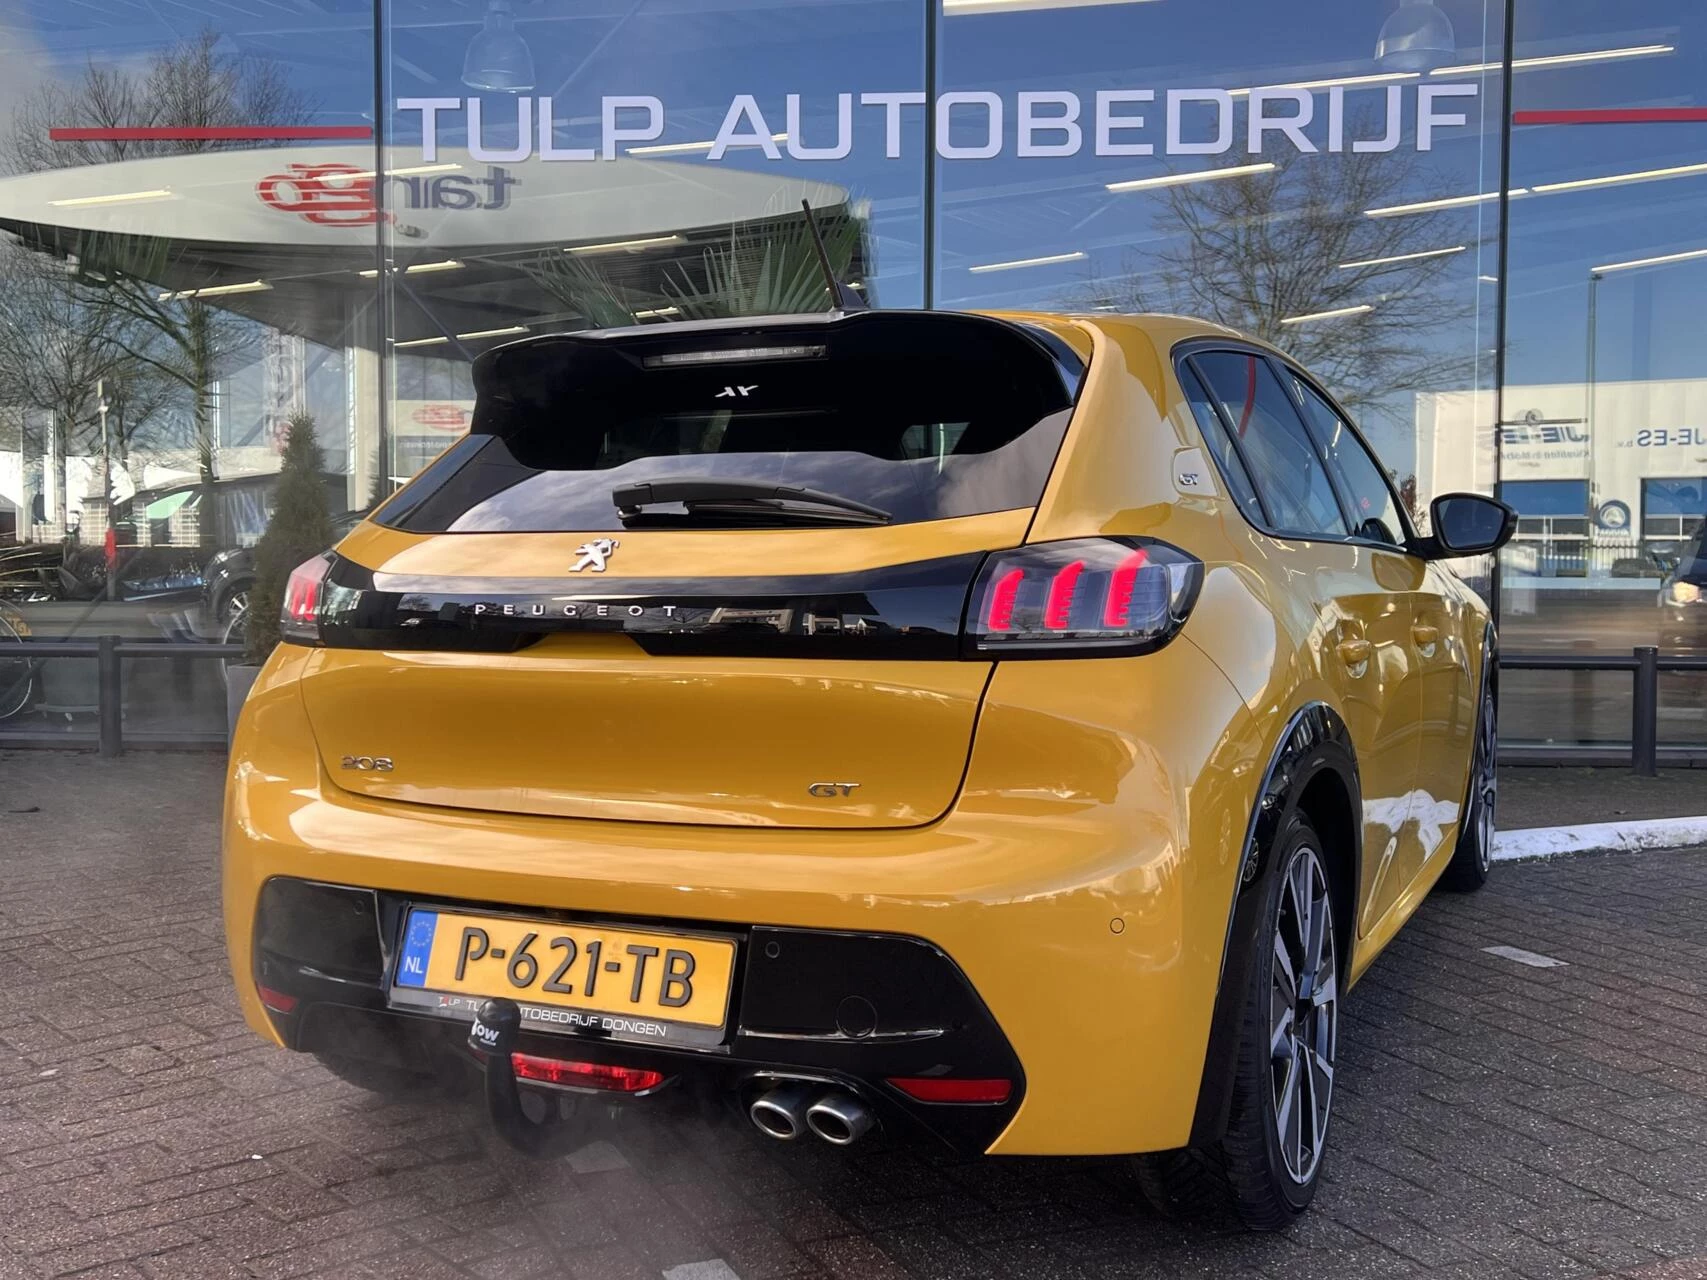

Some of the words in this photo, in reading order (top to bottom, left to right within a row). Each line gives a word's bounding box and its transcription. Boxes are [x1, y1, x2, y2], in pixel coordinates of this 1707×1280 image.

[397, 95, 665, 162] TULP
[706, 83, 1479, 161] AUTOBEDRIJF
[474, 603, 677, 618] PEUGEOT
[341, 755, 394, 772] 208
[808, 782, 861, 798] GT
[404, 956, 423, 974] NL
[455, 926, 697, 1008] P-621-TB
[520, 1007, 599, 1027] TOBEDRIJF
[601, 1018, 667, 1037] DONGEN
